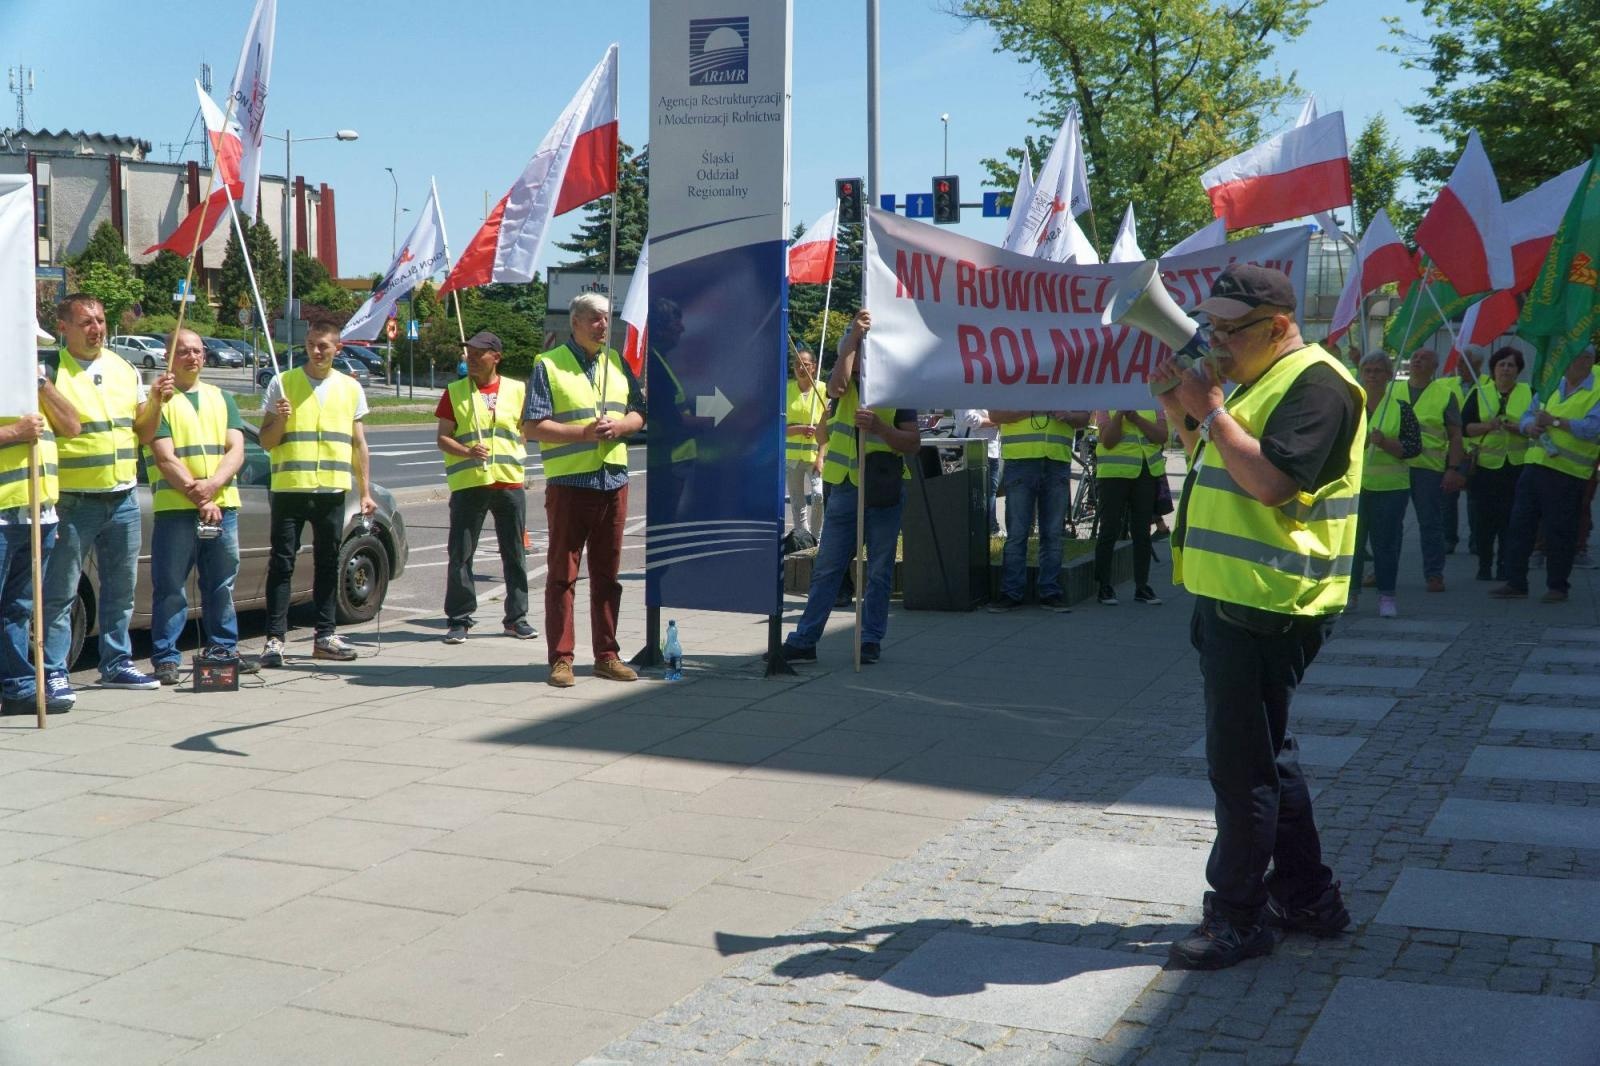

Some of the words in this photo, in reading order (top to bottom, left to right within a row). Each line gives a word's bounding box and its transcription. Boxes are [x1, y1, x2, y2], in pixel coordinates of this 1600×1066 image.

[658, 96, 698, 111] Agencja
[701, 92, 782, 109] Restrukturyzacji
[664, 112, 729, 127] Modernizacji
[732, 111, 781, 124] Rolnictwa
[701, 149, 734, 166] Śląski
[696, 168, 740, 182] Oddział
[687, 185, 749, 200] Regionalny
[895, 248, 947, 303] MY
[957, 323, 1174, 386] ROLNIKA
